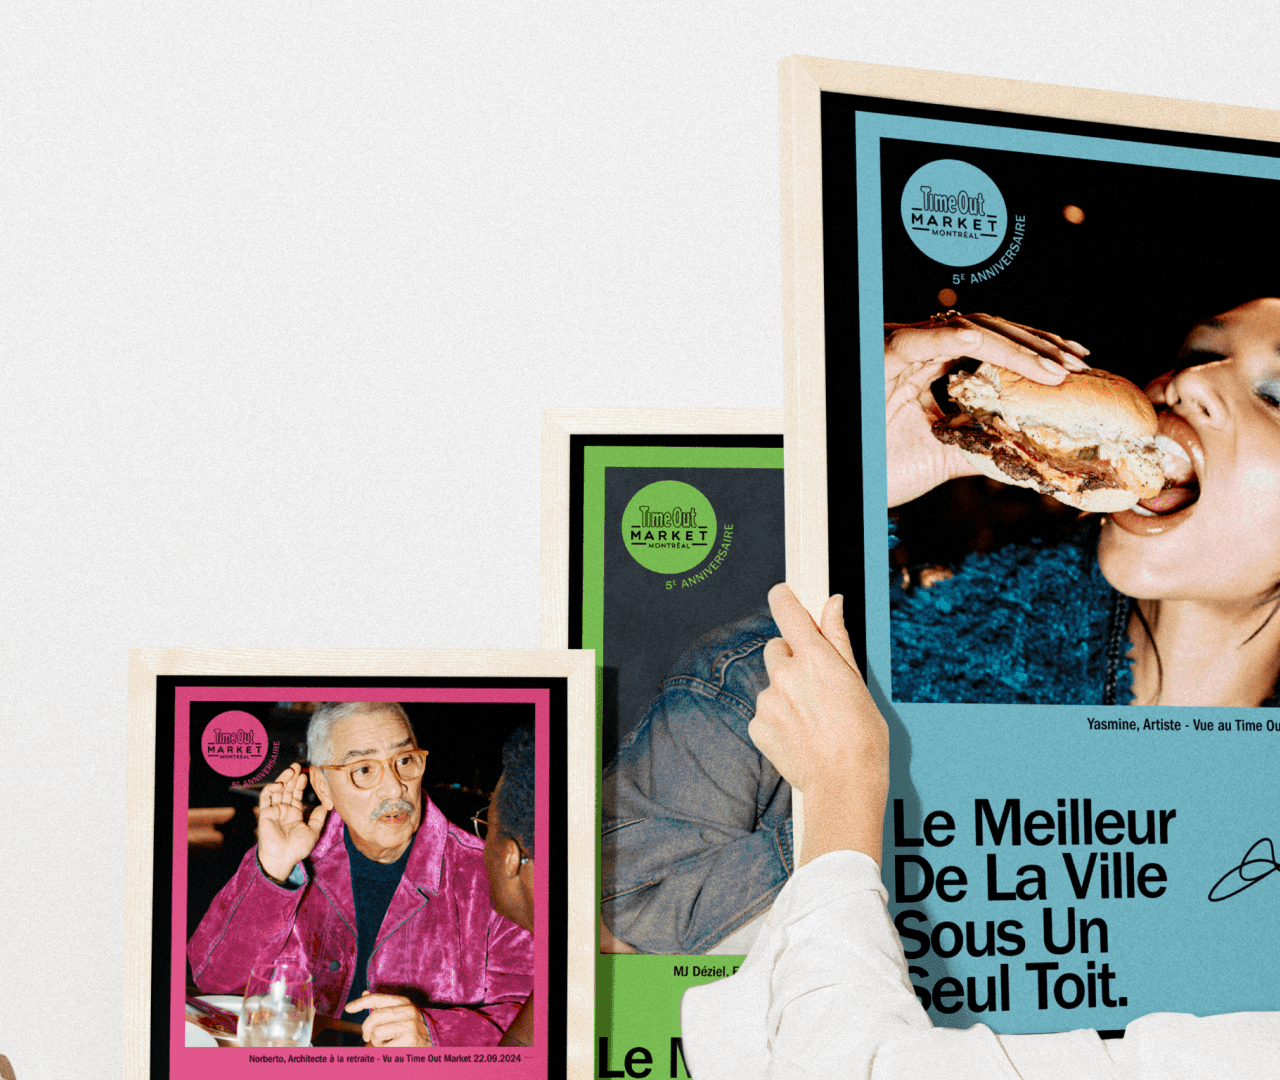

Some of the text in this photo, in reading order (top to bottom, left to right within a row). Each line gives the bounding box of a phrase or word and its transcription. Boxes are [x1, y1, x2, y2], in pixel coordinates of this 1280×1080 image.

[912, 212, 997, 232] MARKET
[932, 229, 979, 239] MONTRÉAL
[970, 214, 1026, 284] ANNIVERSAIRE
[630, 530, 708, 541] MARKET
[681, 523, 734, 589] ANNIVERSAIRE
[1087, 717, 1140, 733] Yasmine,
[1142, 718, 1181, 731] Artiste
[1193, 719, 1214, 732] Vue
[1217, 721, 1232, 732] au
[1235, 719, 1263, 732] Time
[893, 798, 1176, 847] Le Meilleur
[894, 854, 967, 903] De
[986, 853, 1047, 901] La
[1063, 851, 1168, 900] Ville
[894, 907, 1109, 960] Sous Un
[674, 966, 689, 977] MJ
[1026, 960, 1128, 1009] Toit.
[249, 1054, 286, 1064] Norberto,
[288, 1054, 327, 1063] Architecte
[336, 1054, 344, 1063] la
[346, 1054, 375, 1063] retraite
[382, 1054, 392, 1063] Vu
[406, 1054, 425, 1063] Time
[428, 1054, 441, 1063] Out
[444, 1054, 472, 1063] Market
[473, 1054, 521, 1063] 22.09.2024
[598, 1036, 653, 1079] Le
